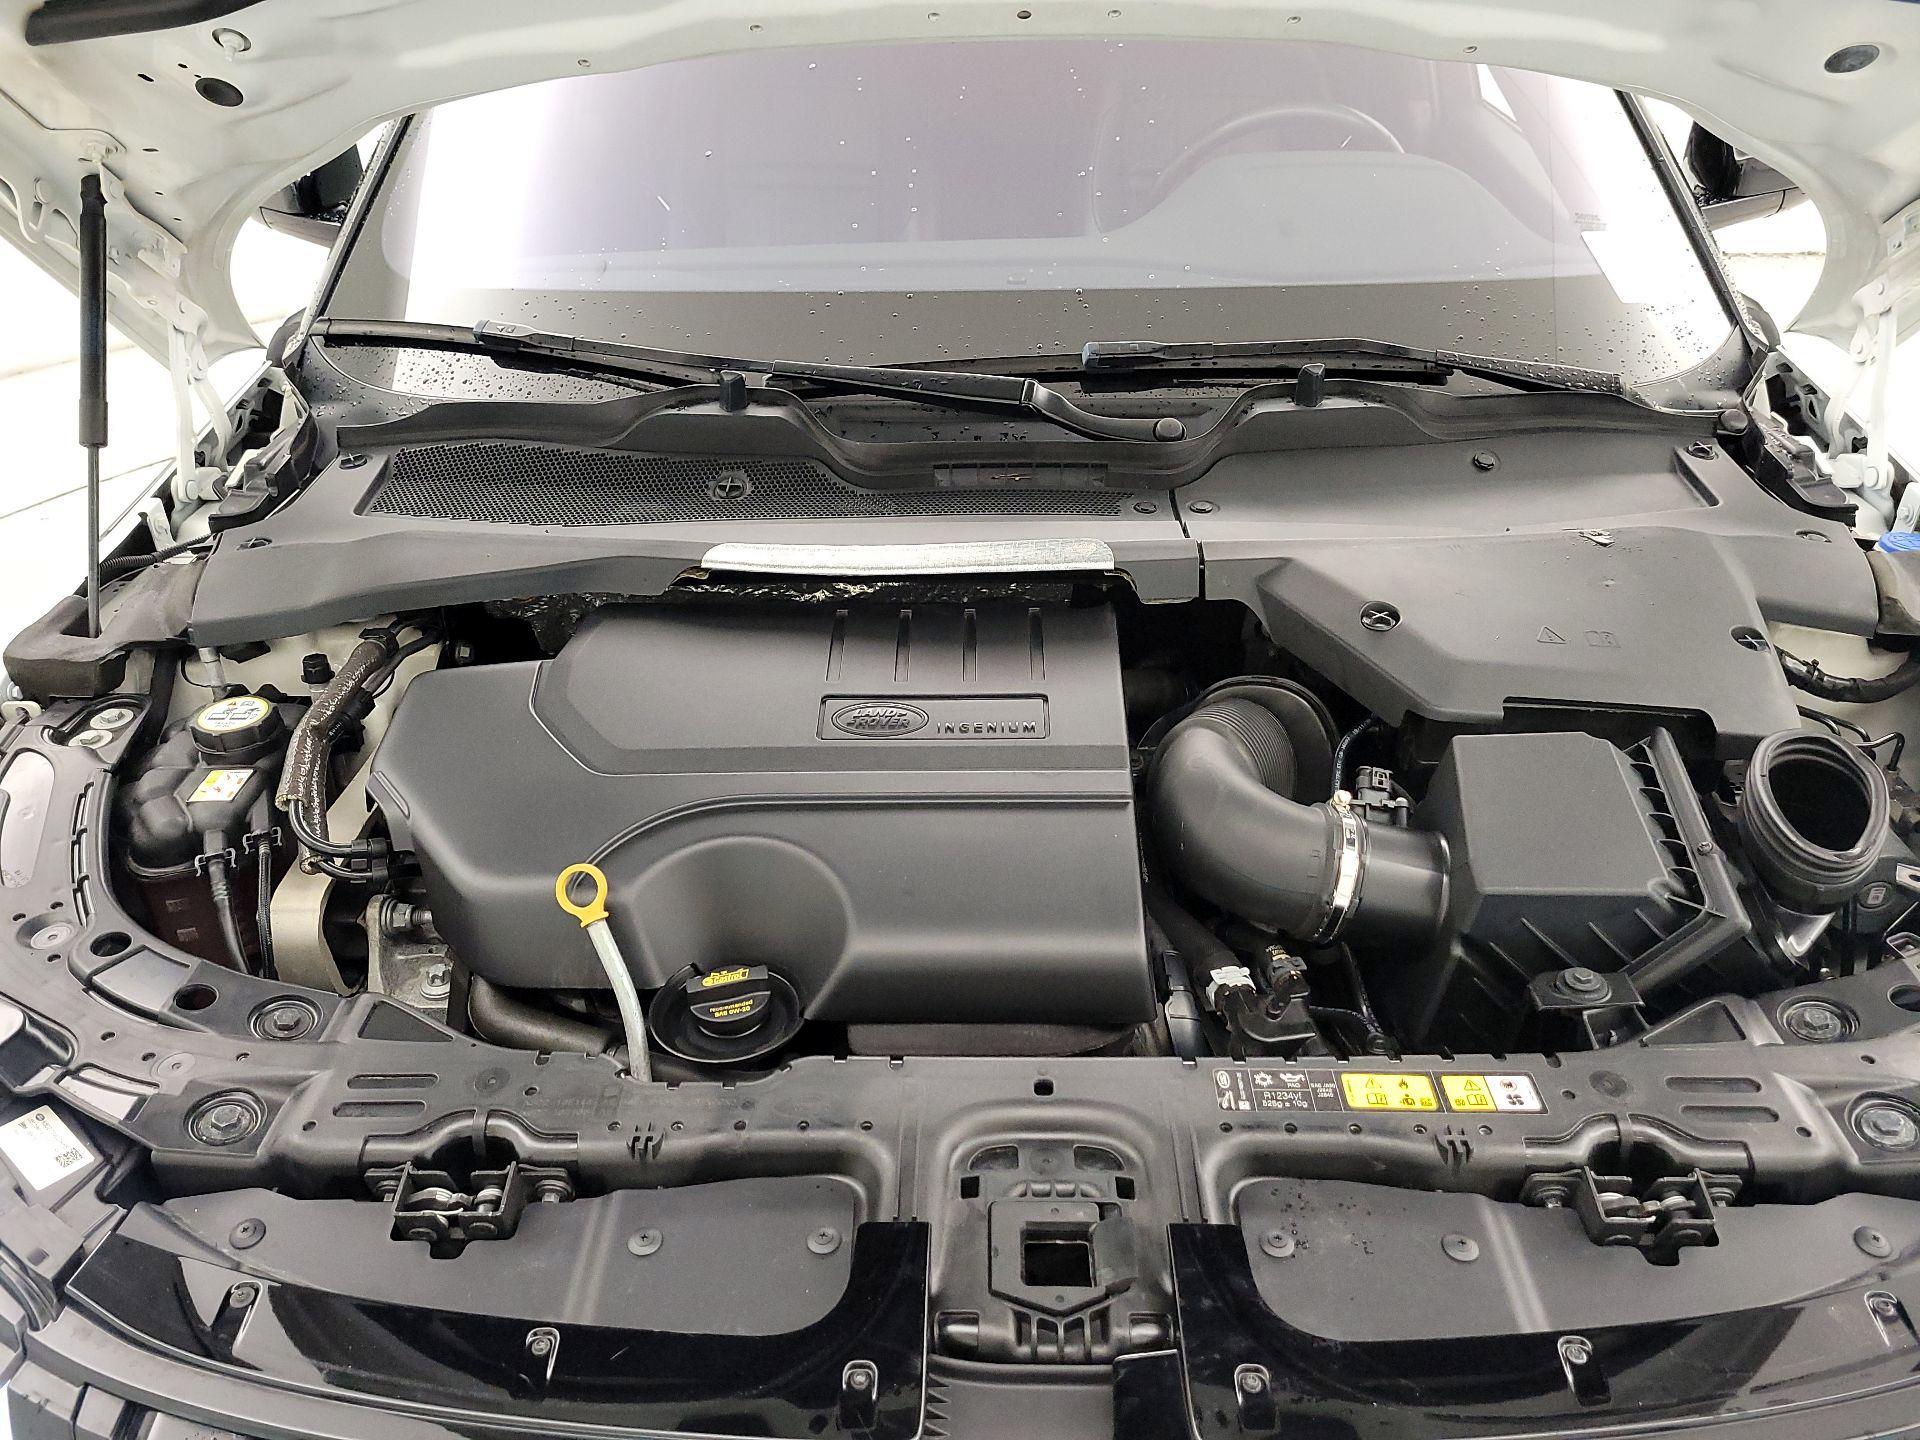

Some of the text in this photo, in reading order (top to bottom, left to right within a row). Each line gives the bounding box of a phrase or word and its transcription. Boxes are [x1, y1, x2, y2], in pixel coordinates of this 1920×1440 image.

[852, 708, 898, 719] LAND
[854, 717, 910, 730] ROVER
[937, 721, 1036, 734] INGENIUM
[1263, 1092, 1302, 1101] R1234yf
